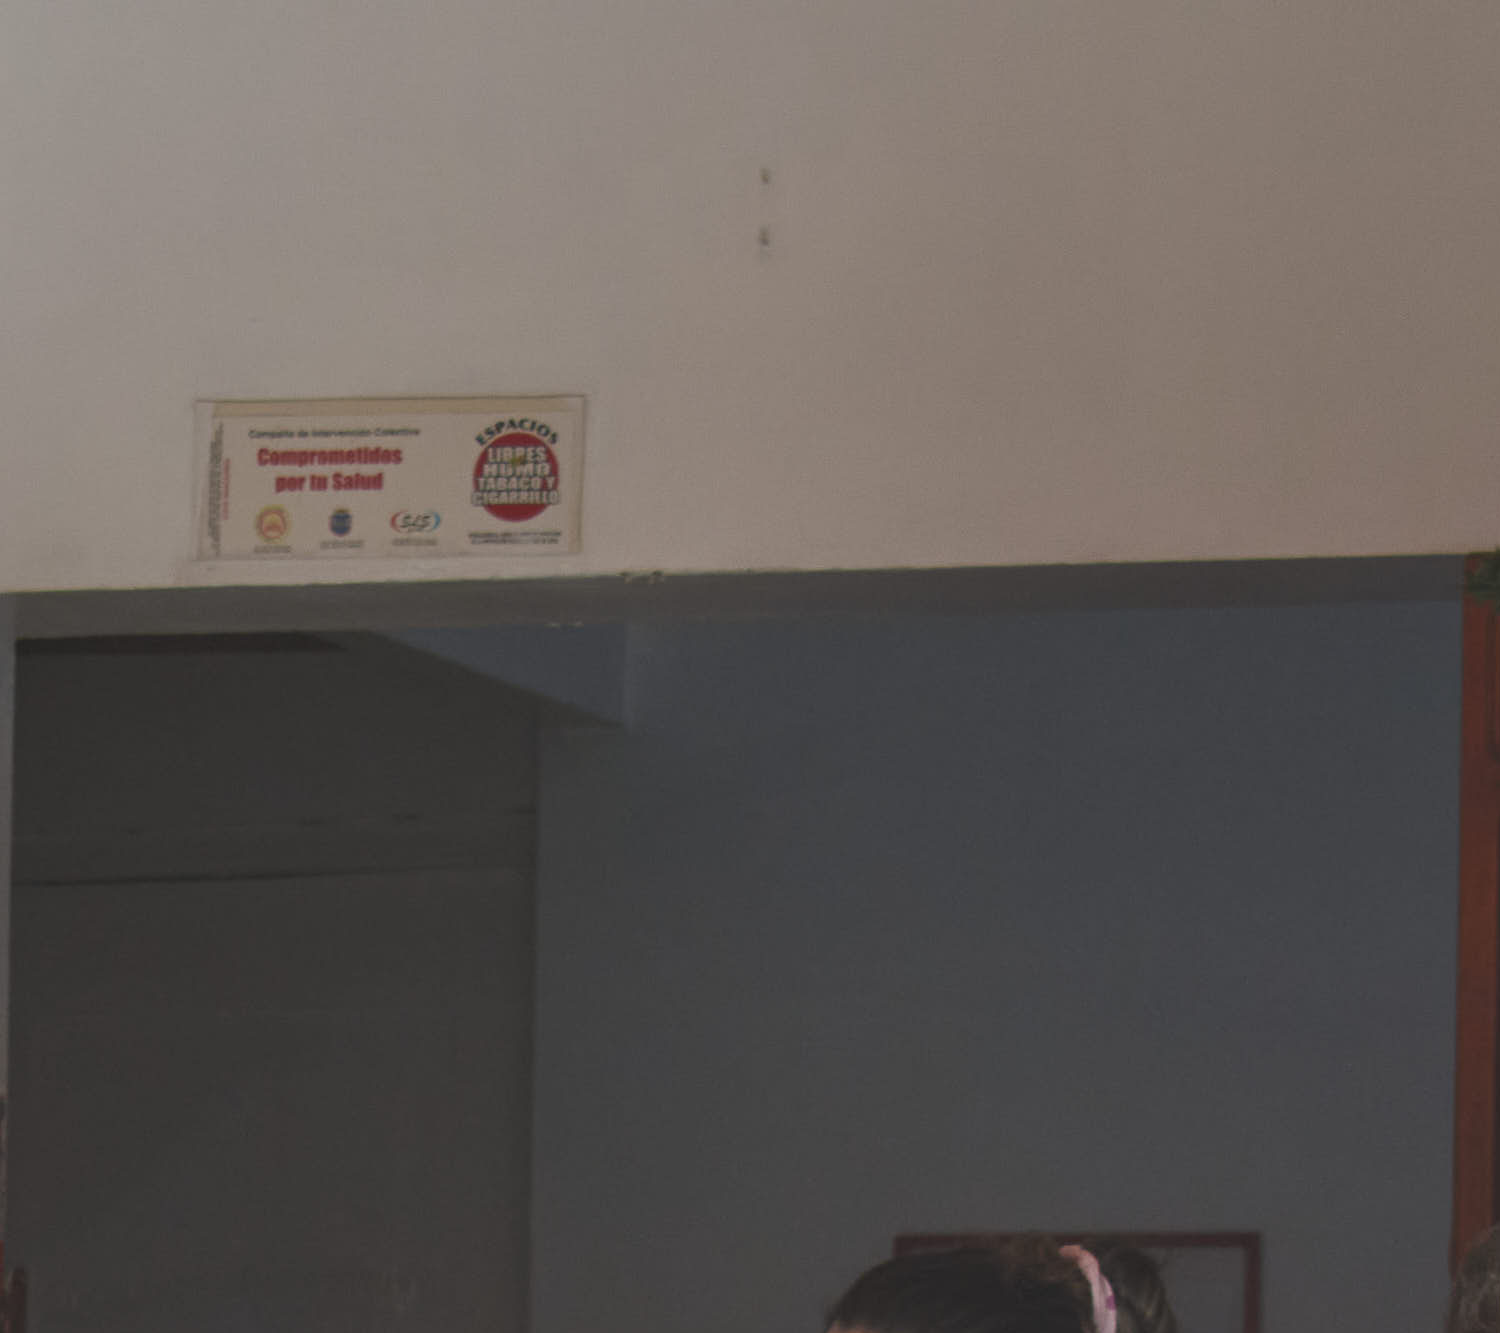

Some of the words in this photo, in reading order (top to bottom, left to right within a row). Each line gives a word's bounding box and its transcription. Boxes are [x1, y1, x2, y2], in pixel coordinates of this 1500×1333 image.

[475, 418, 559, 446] ESPACIOS
[257, 447, 403, 467] Comprometidos
[275, 475, 306, 493] por
[332, 471, 384, 491] Salud
